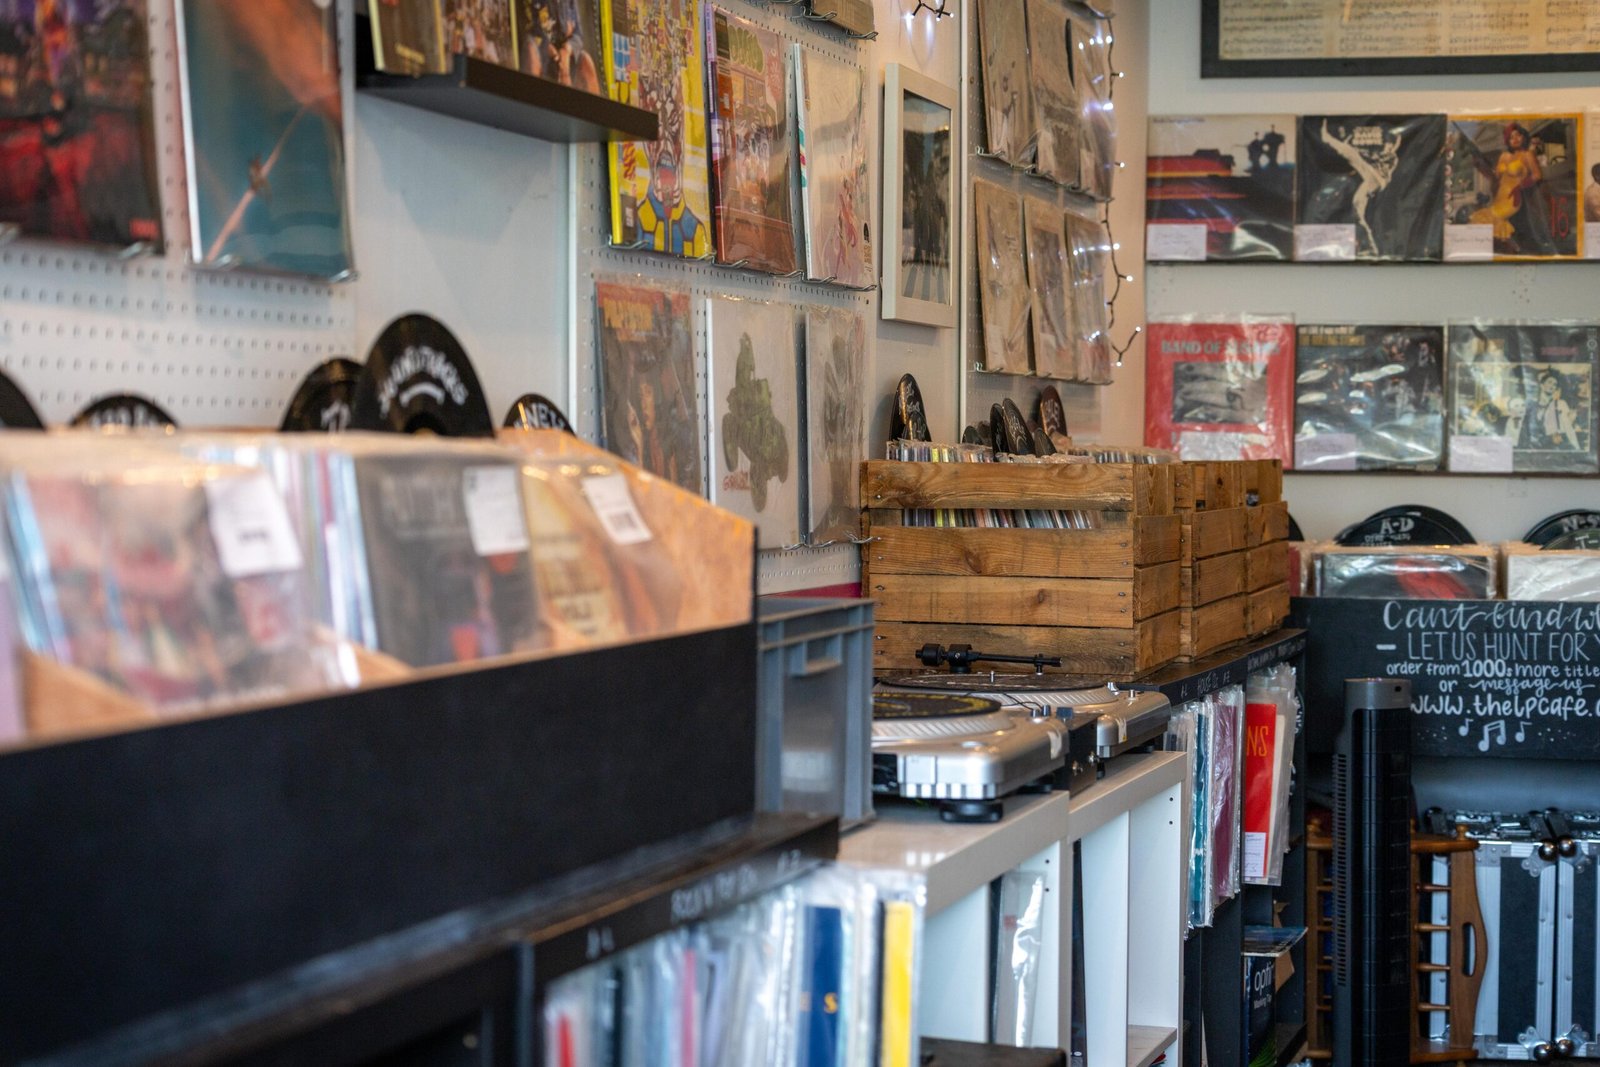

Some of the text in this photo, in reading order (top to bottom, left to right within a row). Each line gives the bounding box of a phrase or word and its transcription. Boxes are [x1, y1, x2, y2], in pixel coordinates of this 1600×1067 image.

[1551, 195, 1569, 240] 16
[1380, 517, 1415, 535] A-D
[1408, 631, 1448, 660] LET
[1452, 631, 1476, 660] US
[1484, 631, 1543, 662] HUNT
[1549, 631, 1591, 662] FOR
[1386, 661, 1423, 676] order
[1426, 662, 1460, 676] from
[1515, 663, 1560, 678] more
[1439, 677, 1595, 698] or message us
